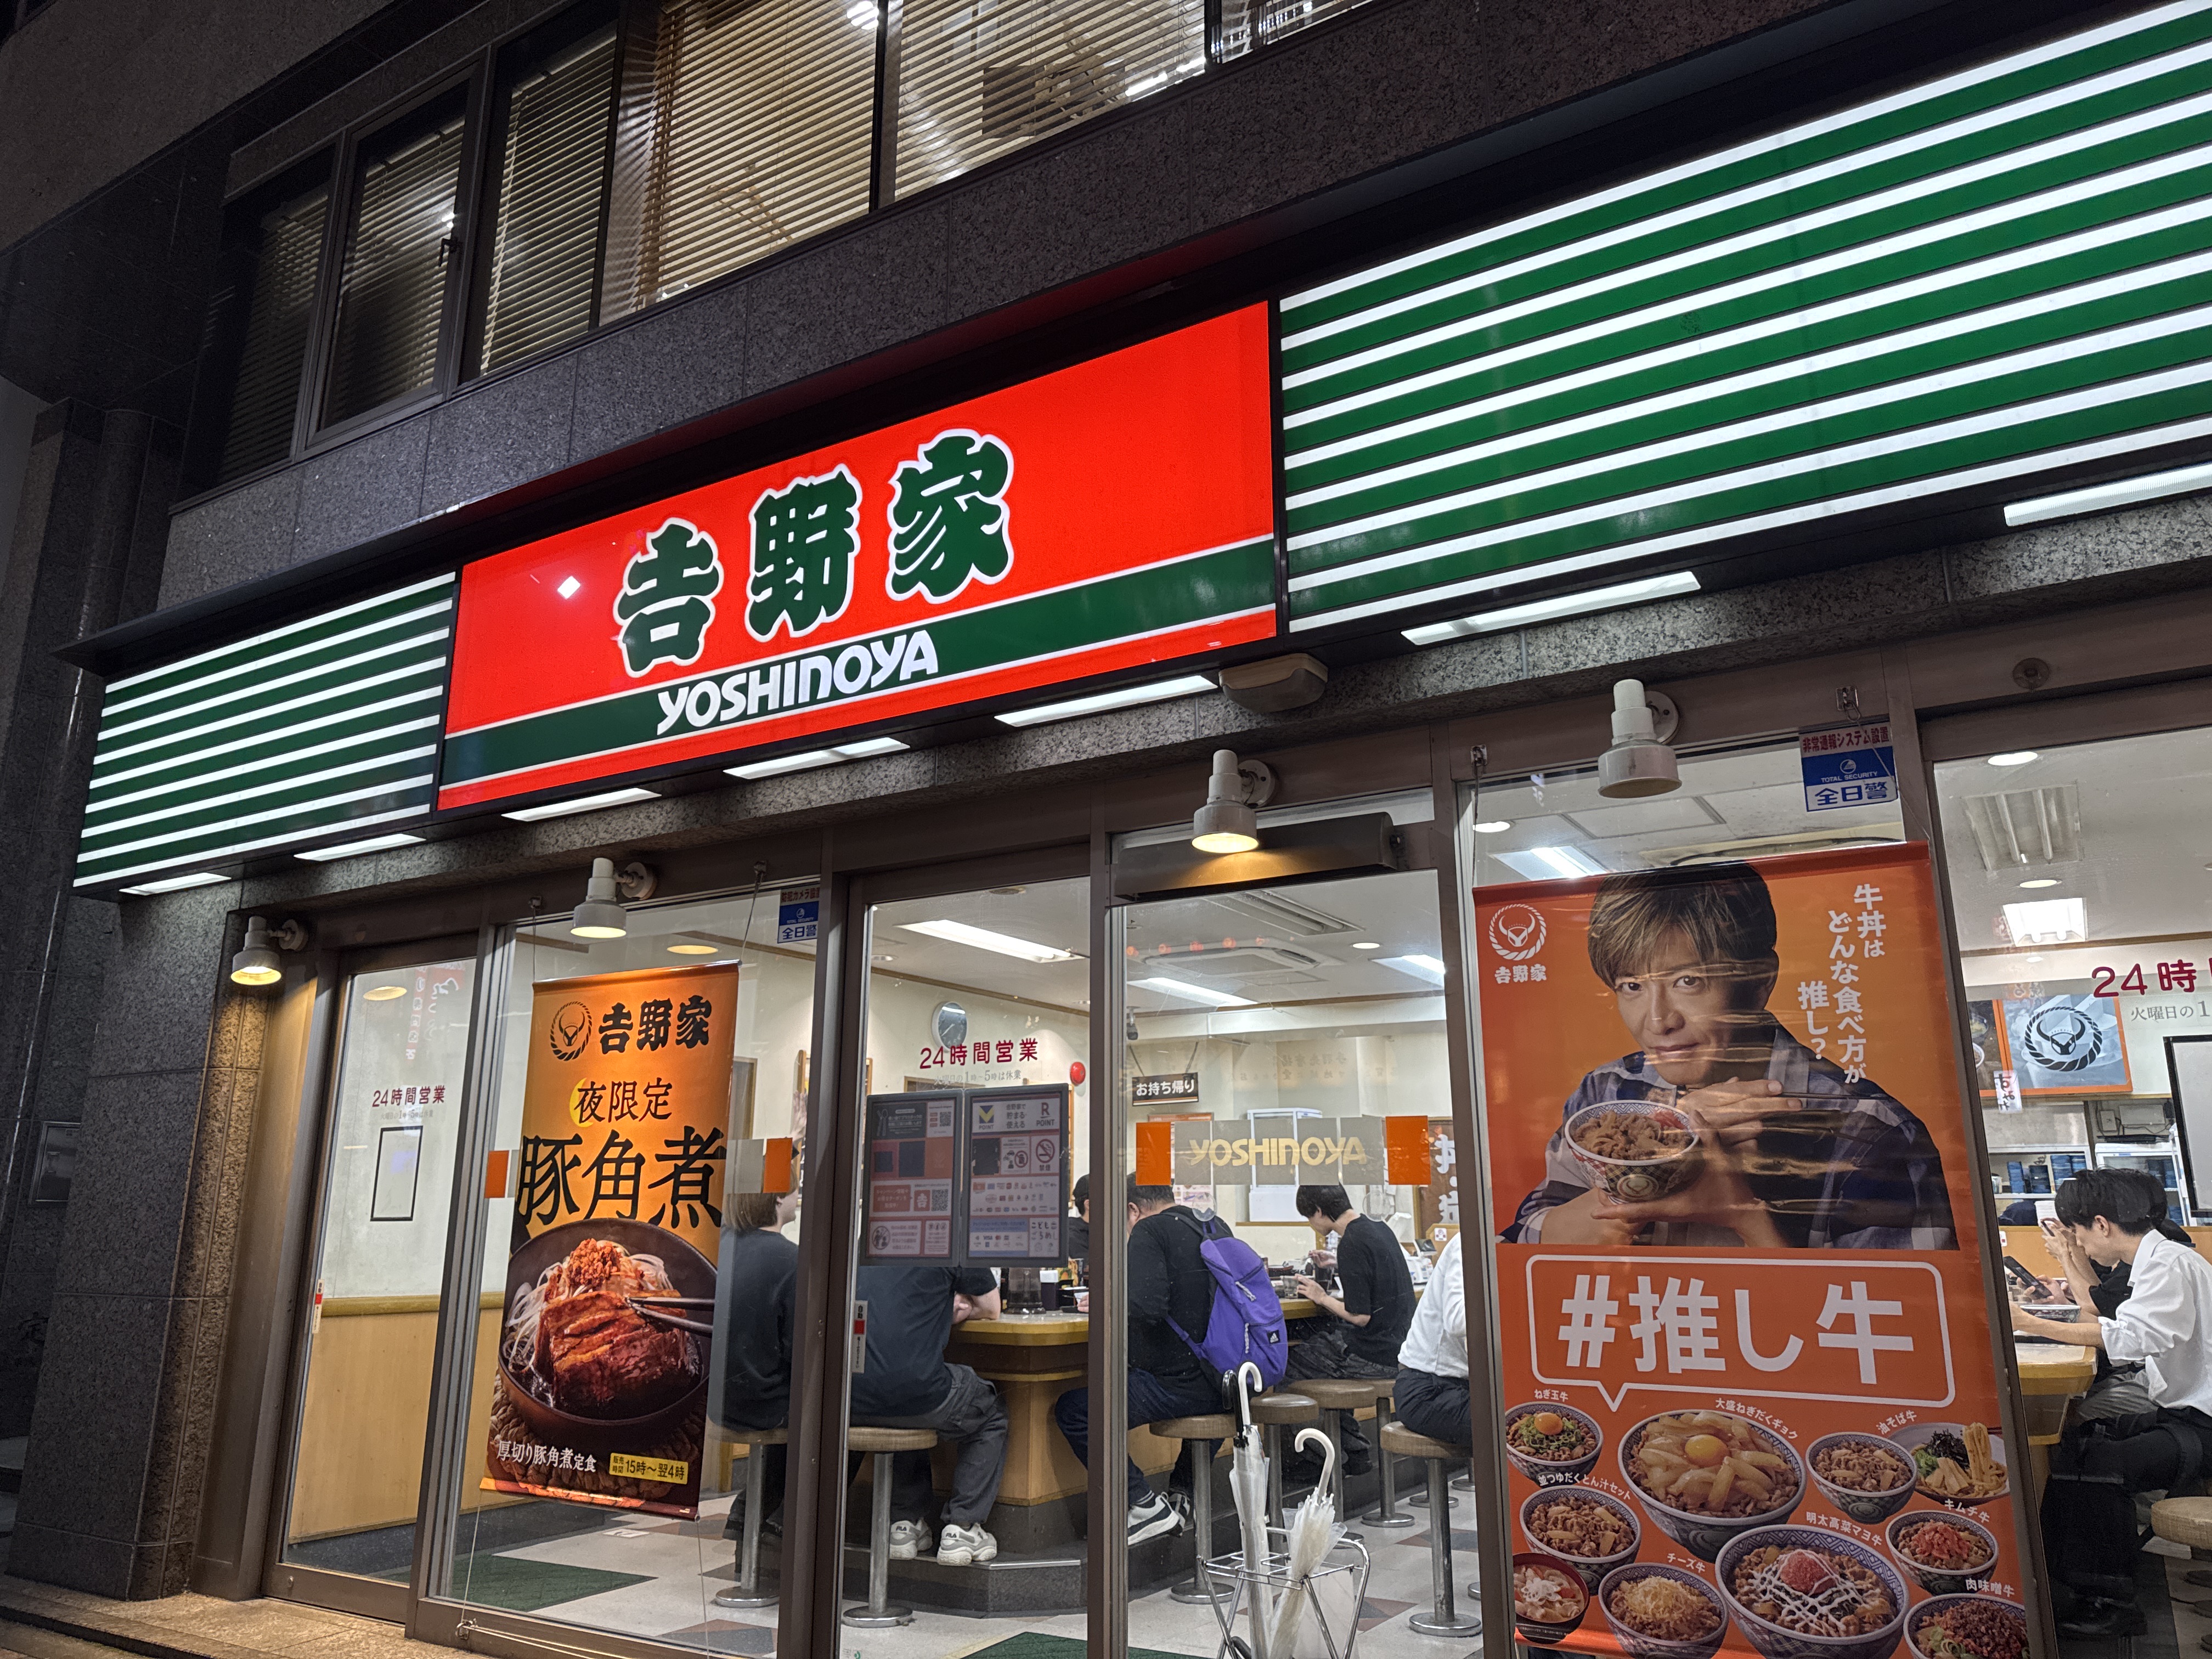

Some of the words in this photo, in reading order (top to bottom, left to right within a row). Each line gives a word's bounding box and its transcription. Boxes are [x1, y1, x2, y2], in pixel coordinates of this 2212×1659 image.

[657, 629, 939, 736] YOSHINOYA
[1803, 726, 1889, 753] 非常通報システム設置
[1844, 771, 1877, 781] SECURITY
[1815, 781, 1888, 806] 全日警
[782, 924, 817, 940] 全日警
[1854, 884, 1886, 958] 牛丼は
[2092, 958, 2212, 997] 24時
[1828, 910, 1867, 1084] どんな食べ方が
[2131, 1000, 2210, 1022] 火曜日の1
[919, 1038, 1038, 1069] 24時間営業
[372, 1085, 445, 1108] 24時間営業
[574, 1077, 673, 1124] 夜限定
[1136, 1079, 1194, 1096] お持ち帰り
[1006, 1121, 1025, 1129] 使える
[1189, 1136, 1366, 1166] YOSHINOYA
[515, 1126, 727, 1229] 豚角煮
[1558, 1274, 1914, 1385] #推し牛
[1534, 1389, 1568, 1402] ねぎ玉牛
[1716, 1397, 1799, 1440] 大盛ねぎだくギョク
[1875, 1410, 1917, 1435] 油そば牛
[496, 1440, 597, 1473] 厚切り豚角煮定食
[1538, 1472, 1632, 1501] 並つゆだくとん汁セット
[1944, 1498, 1990, 1524] キムチ牛
[1805, 1511, 1883, 1547] 明太高菜マヨ牛
[1667, 1553, 1706, 1574] チーズ牛
[1966, 1578, 2015, 1597] 肉味噌牛
